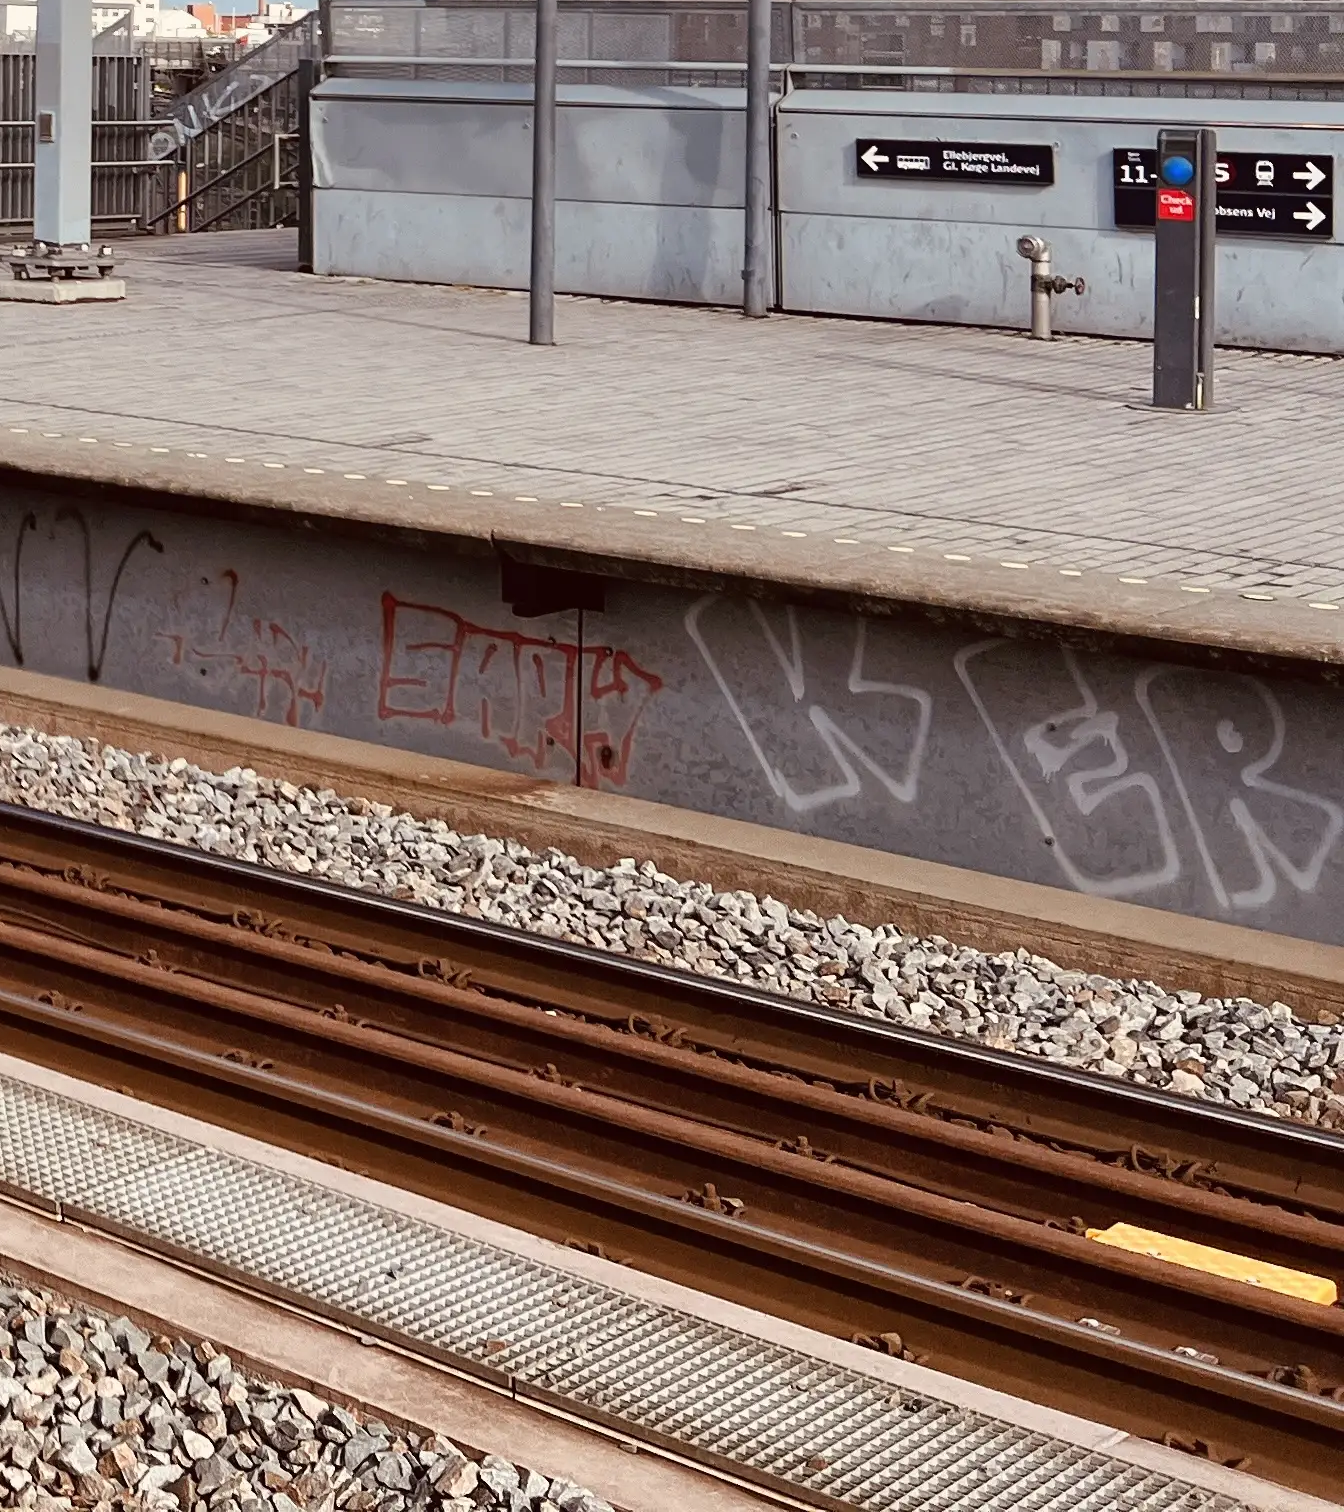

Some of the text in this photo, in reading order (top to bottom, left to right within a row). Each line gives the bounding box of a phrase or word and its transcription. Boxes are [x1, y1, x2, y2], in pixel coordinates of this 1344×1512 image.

[1120, 164, 1158, 184] 11-
[1214, 205, 1276, 220] obsens Vej
